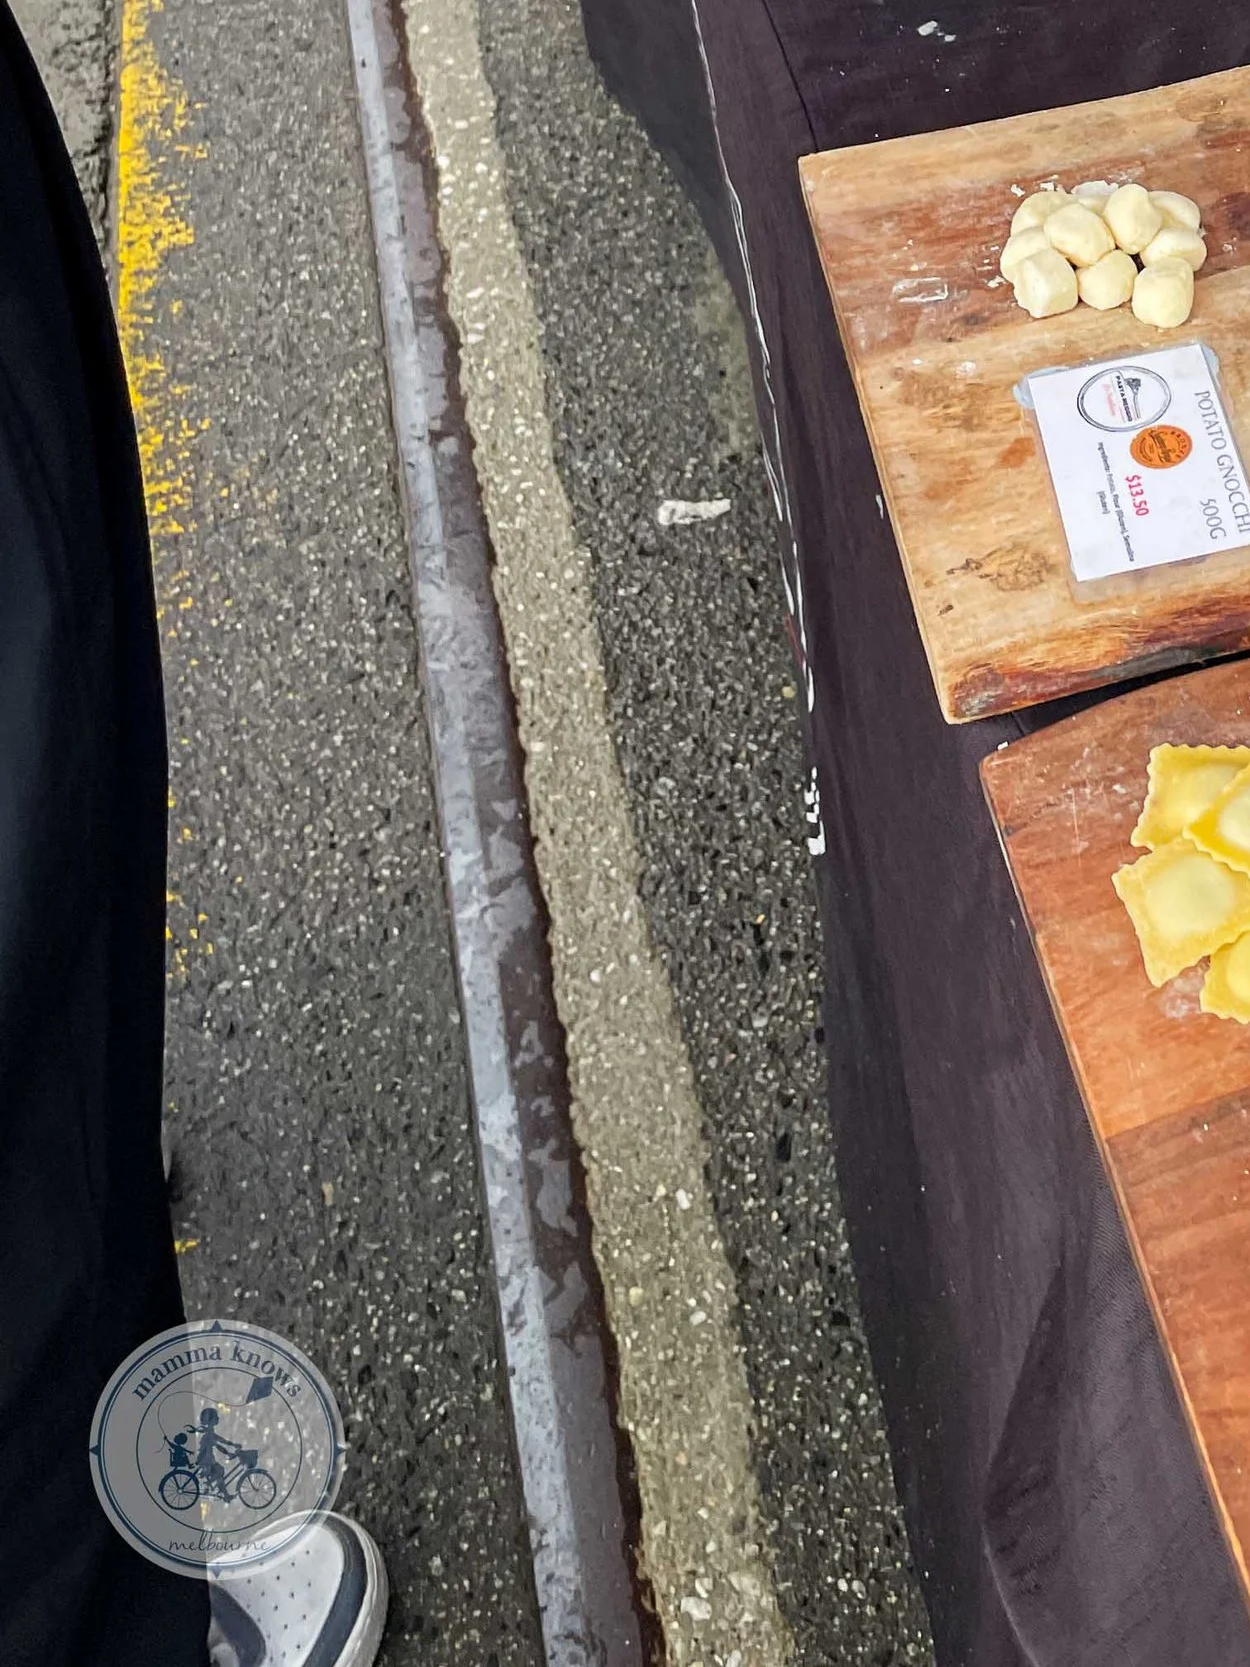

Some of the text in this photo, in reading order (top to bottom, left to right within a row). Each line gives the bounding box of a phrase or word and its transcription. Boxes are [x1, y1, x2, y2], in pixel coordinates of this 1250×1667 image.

[1113, 374, 1126, 398] PASTA
[1193, 389, 1228, 451] POTATO
[1123, 473, 1151, 518] $13.50
[1198, 496, 1227, 540] 500G
